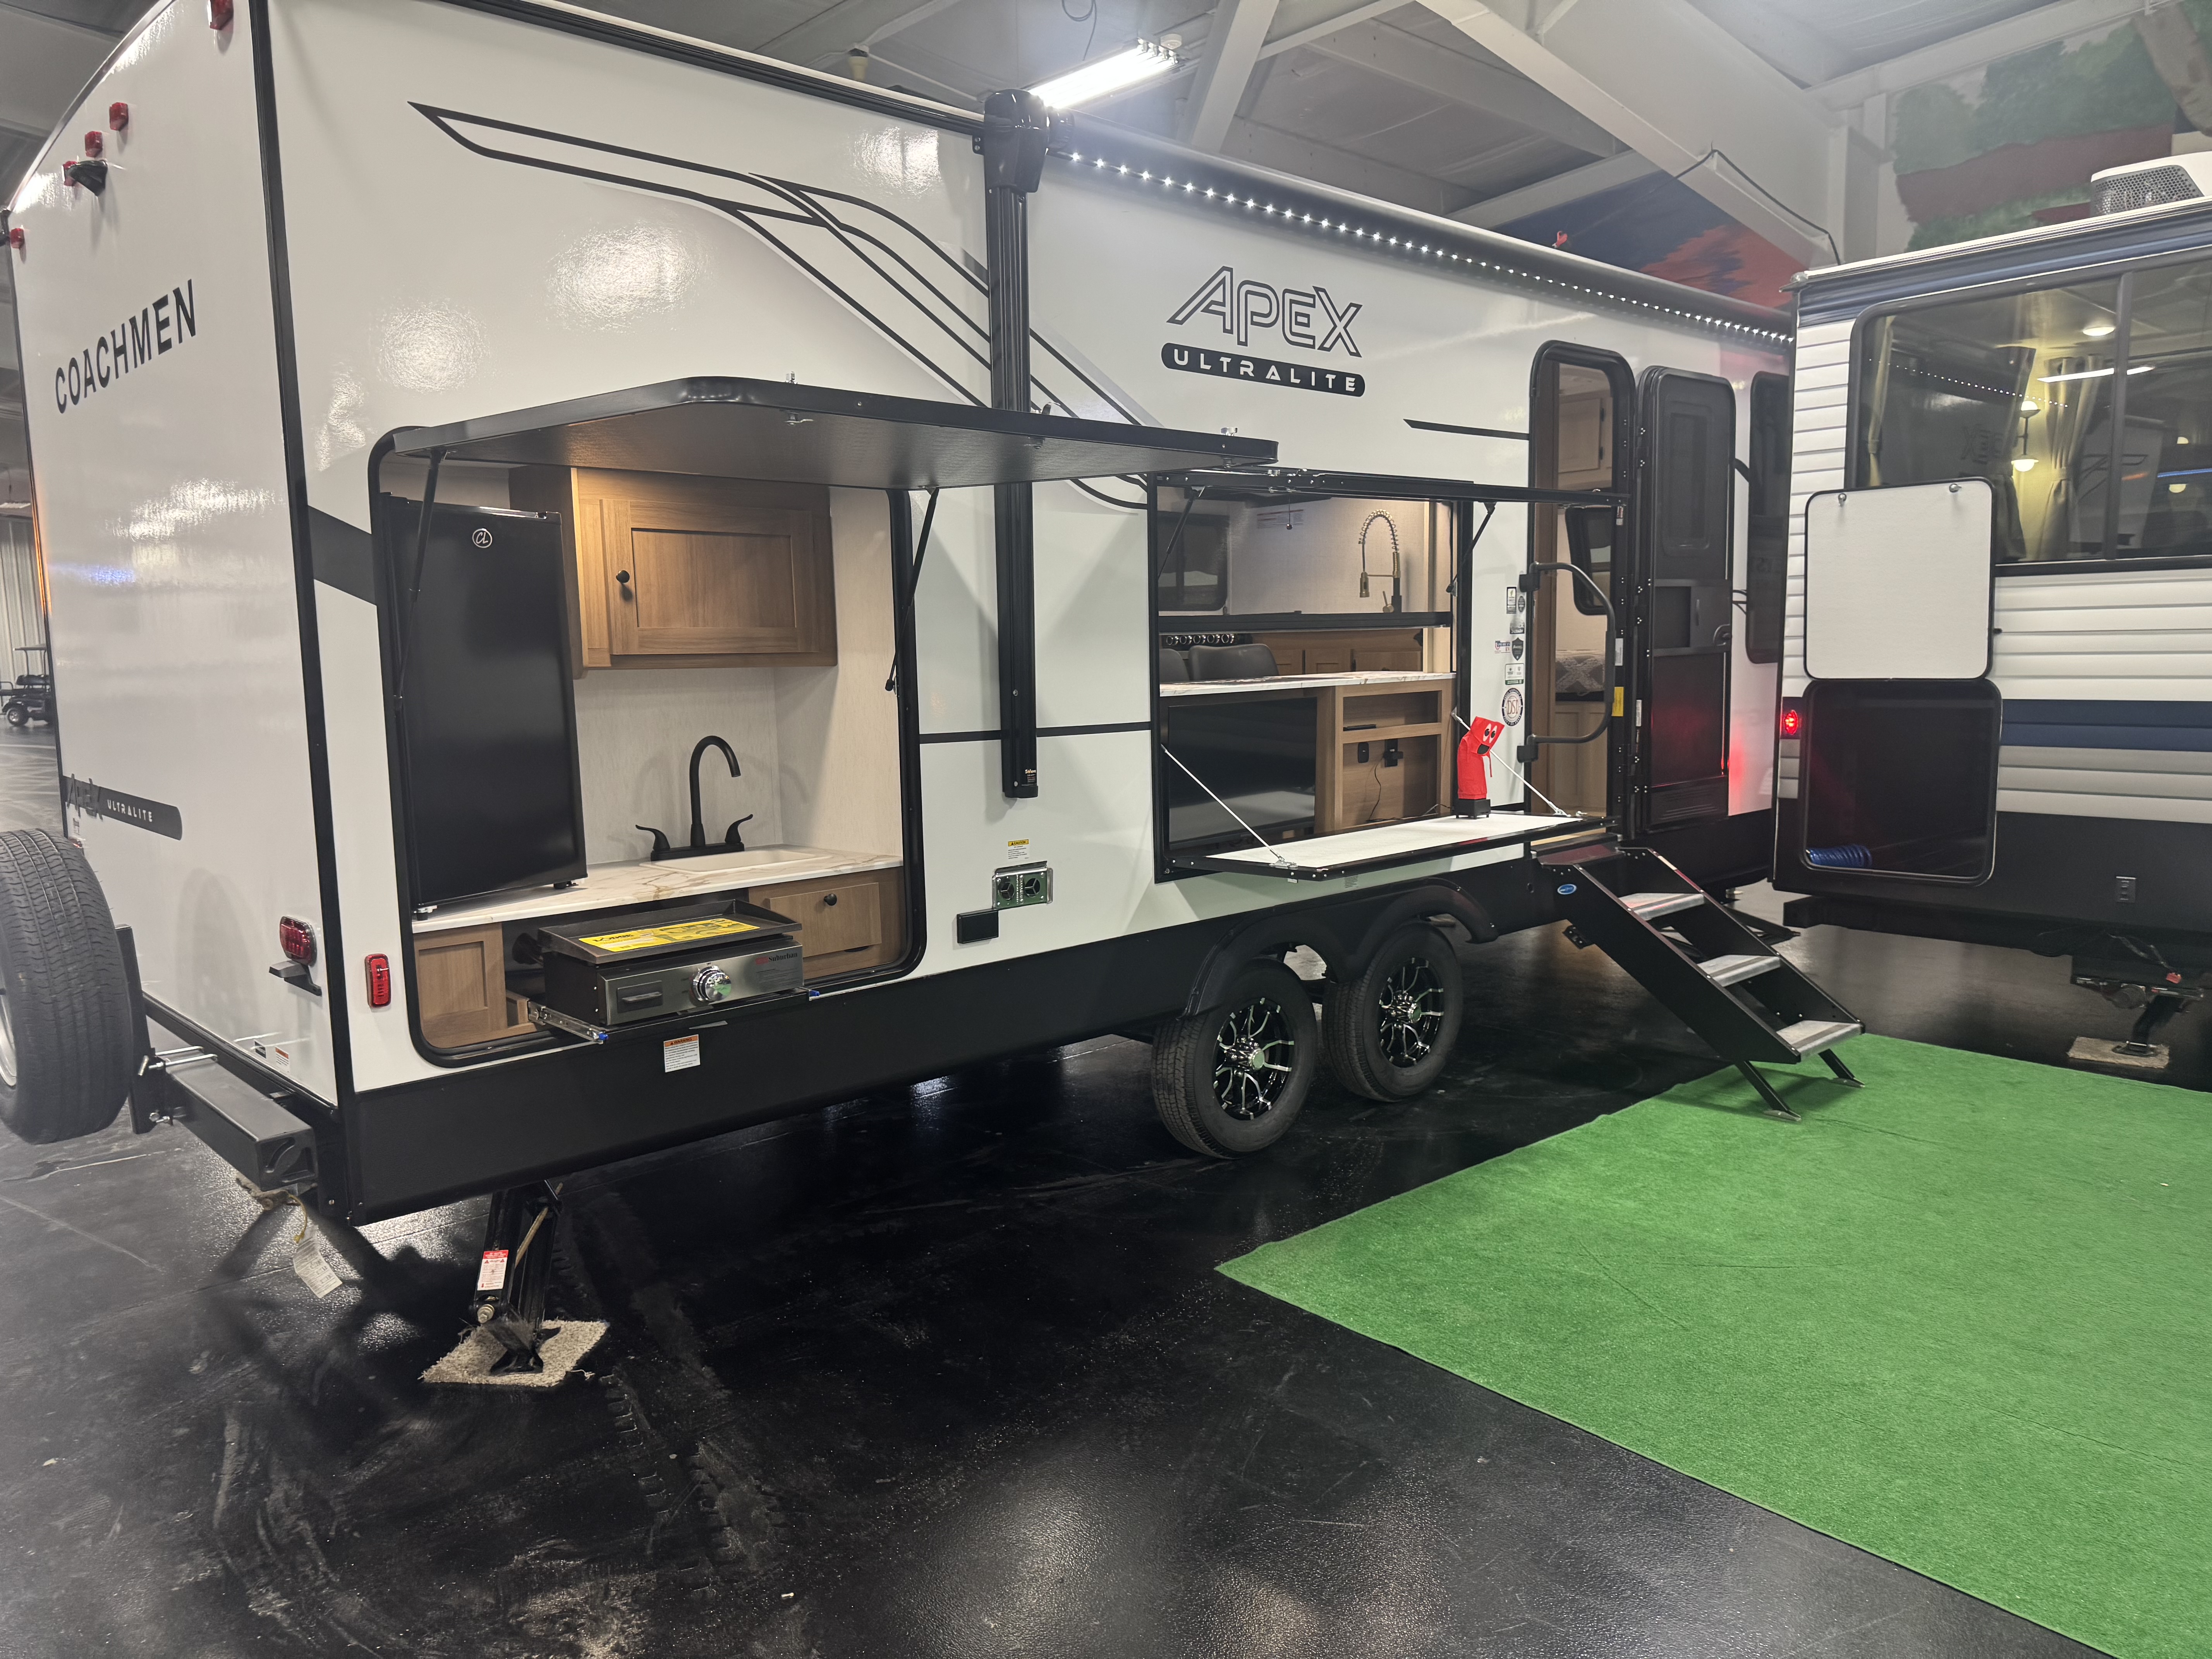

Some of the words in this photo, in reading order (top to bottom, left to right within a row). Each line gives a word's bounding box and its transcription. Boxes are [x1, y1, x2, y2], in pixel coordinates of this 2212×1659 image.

[1166, 266, 1363, 358] APEX
[55, 279, 196, 414] COACHMEN
[1174, 349, 1356, 392] ULTRALITE
[107, 799, 153, 823] ULTRALITE
[768, 952, 798, 962] Suburban
